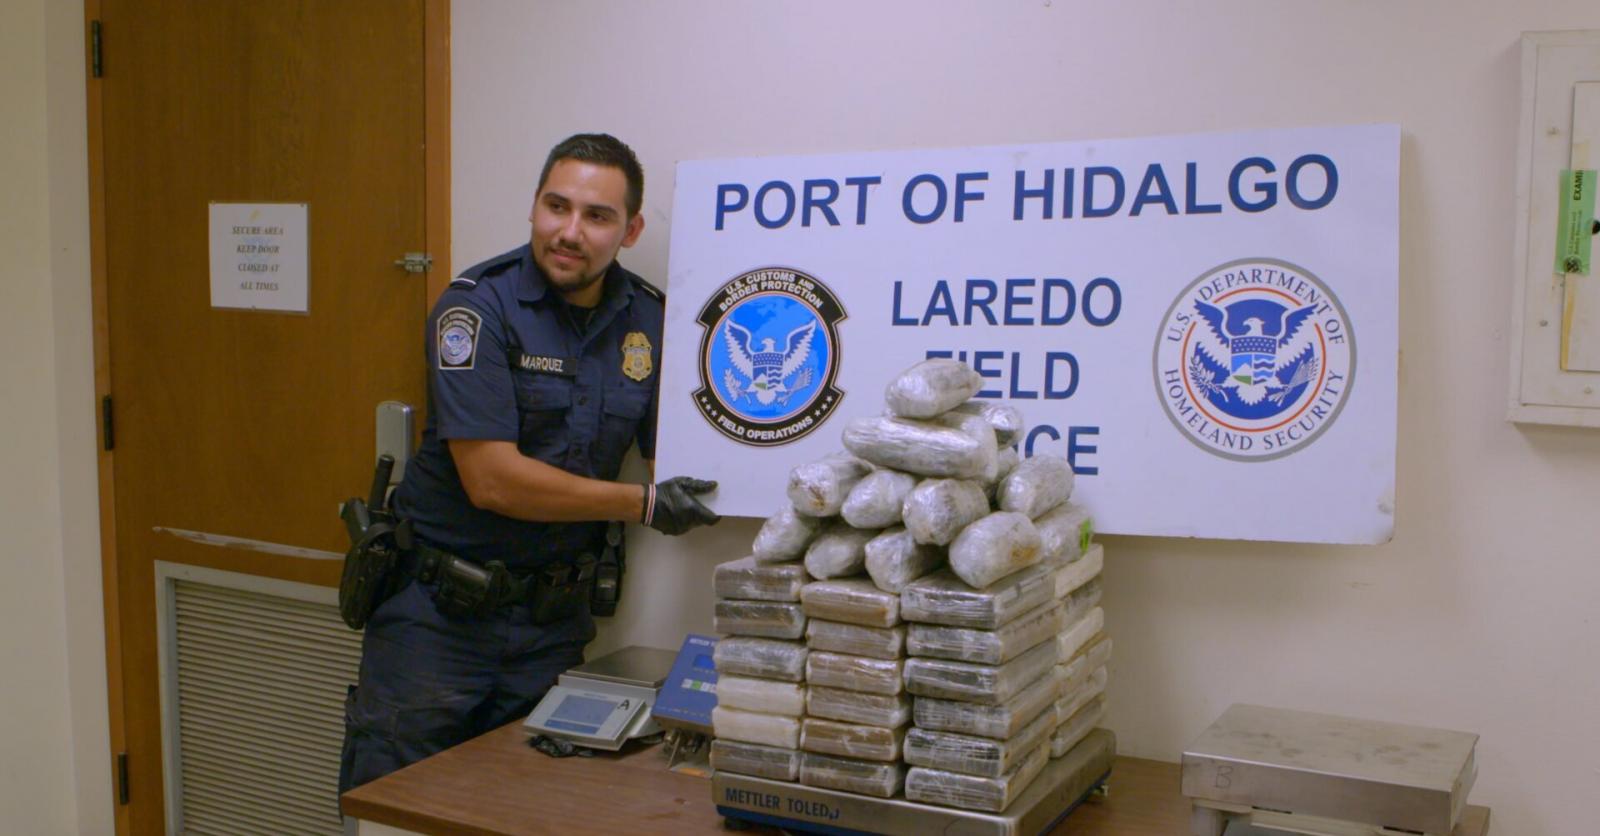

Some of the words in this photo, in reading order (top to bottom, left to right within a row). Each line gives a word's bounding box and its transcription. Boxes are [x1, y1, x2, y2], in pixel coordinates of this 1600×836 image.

[714, 175, 881, 232] PORT
[900, 171, 989, 224] OF
[1013, 153, 1340, 221] HIDALGO
[232, 225, 261, 235] SECURE
[263, 226, 284, 236] AREA
[236, 244, 257, 254] KEEP
[257, 245, 280, 254] DOOR
[238, 263, 268, 272] CLOSED
[270, 264, 280, 273] AT
[240, 281, 253, 290] ALL
[255, 281, 279, 291] TIMES
[725, 281, 745, 295] U.S.
[746, 271, 796, 286] CUSTOMS
[798, 278, 815, 291] AND
[718, 284, 759, 312] BORDER
[761, 280, 824, 309] PROTECTION
[892, 277, 1122, 327] LAREDO
[1167, 311, 1194, 343] U.S.
[1198, 267, 1333, 316] DEPARTMENT
[1325, 318, 1345, 345] OF
[520, 354, 564, 373] MARQUEZ
[925, 350, 1080, 400] ELD
[1164, 368, 1253, 451] HOMELAND
[1263, 369, 1344, 451] SECURITY
[717, 414, 745, 436] FIELD
[746, 415, 814, 440] OPERATIONS
[617, 699, 630, 711] A
[1214, 766, 1233, 789] B
[725, 788, 780, 809] METTLER
